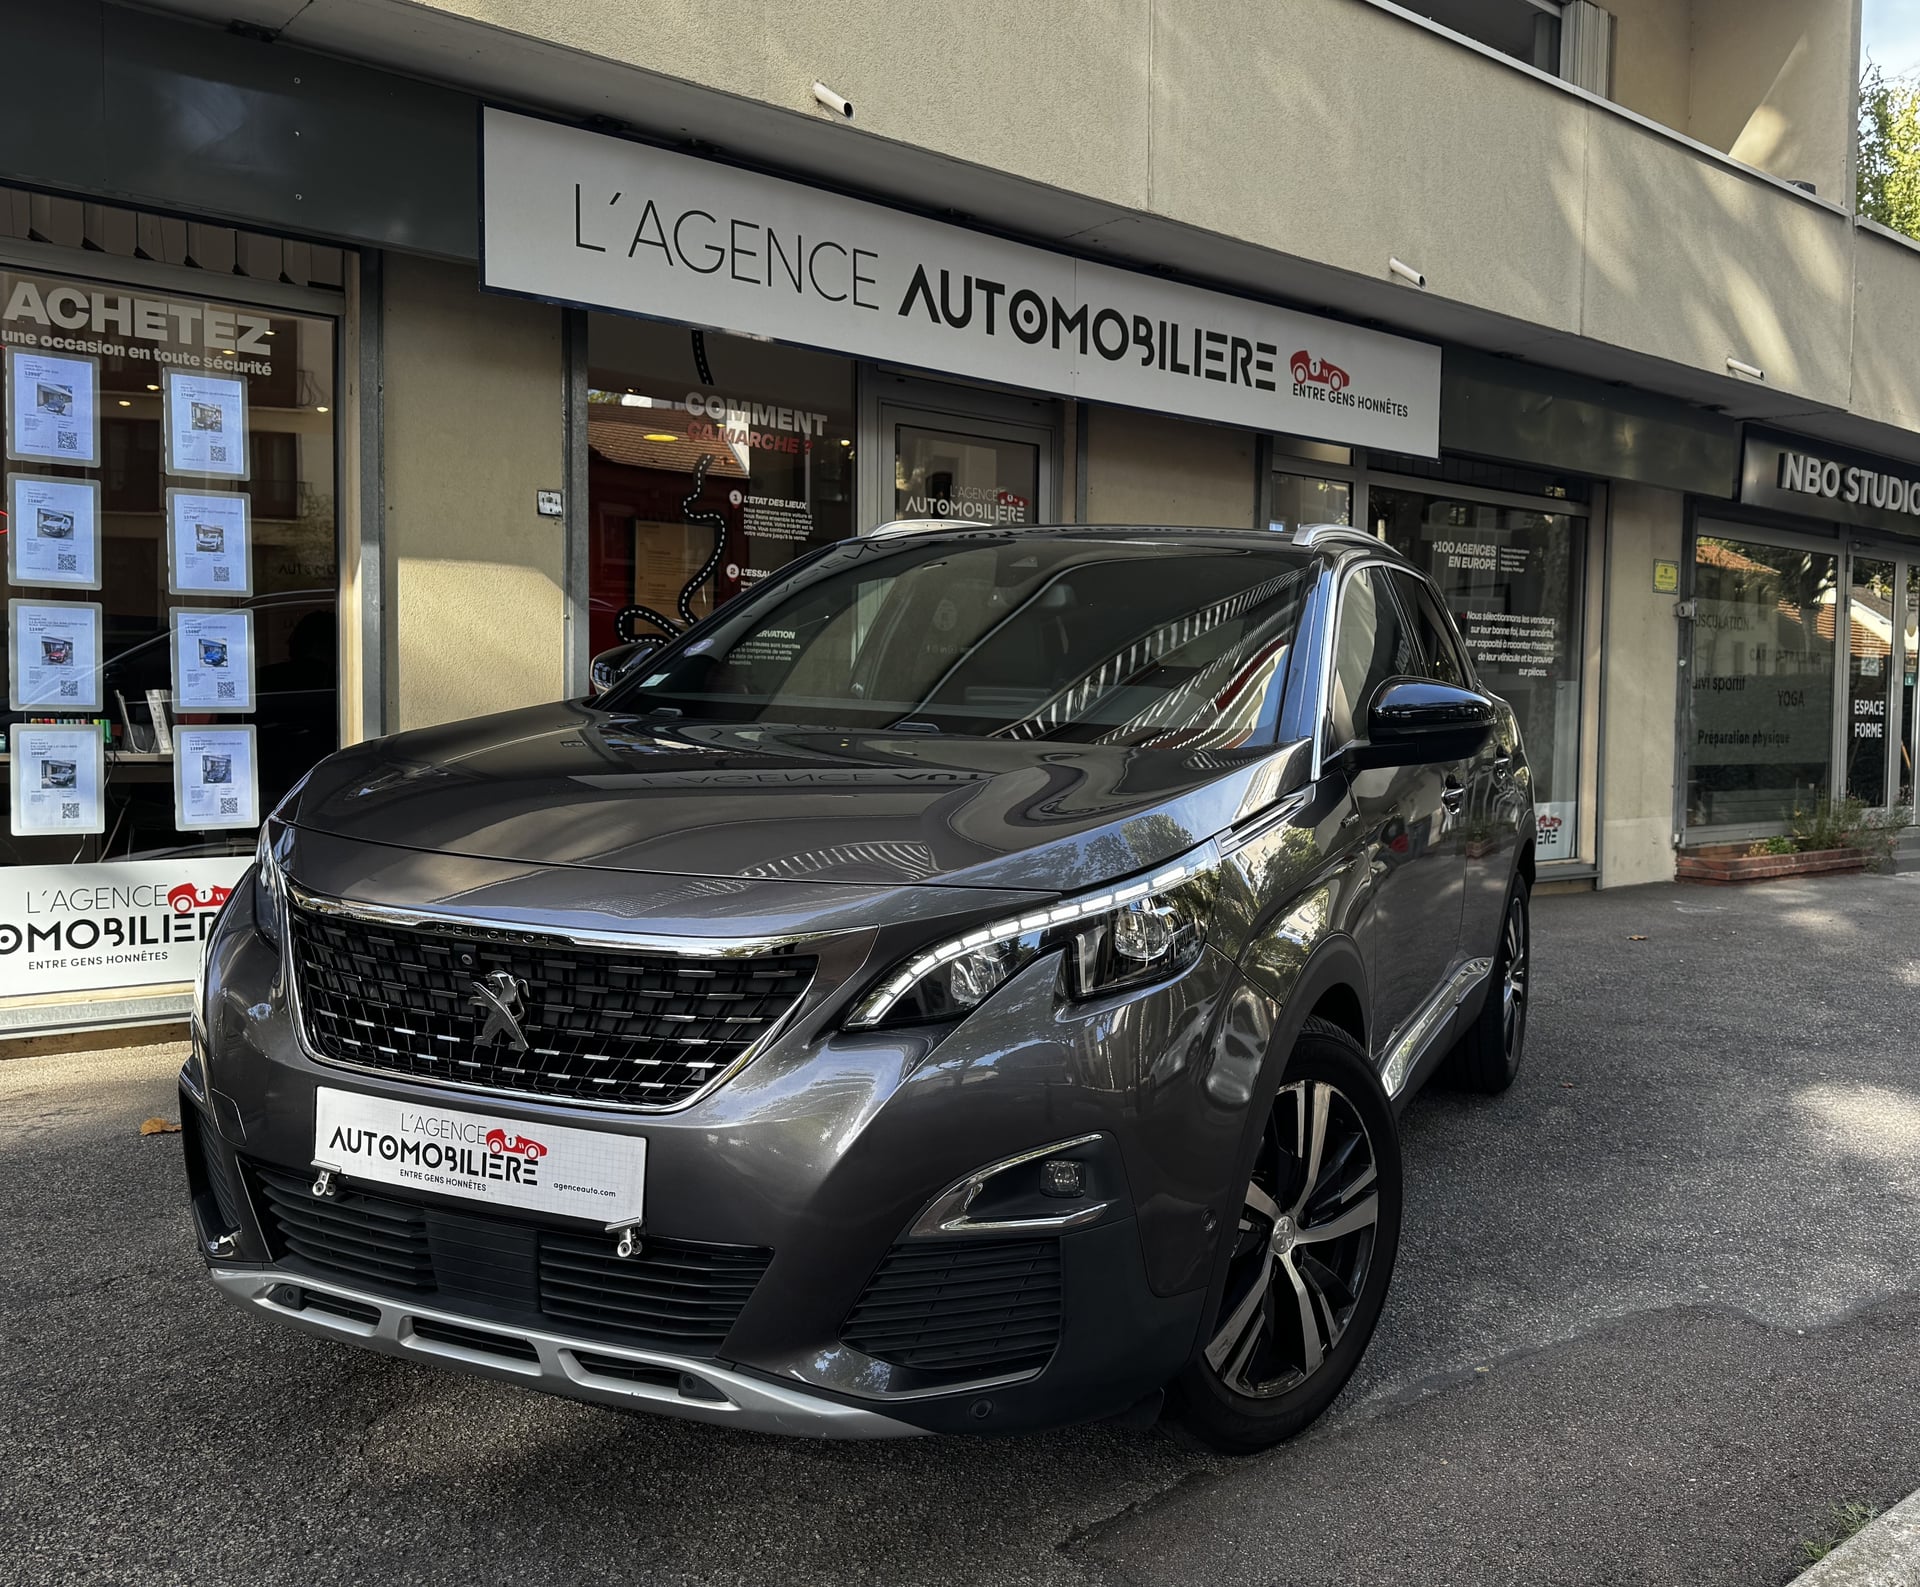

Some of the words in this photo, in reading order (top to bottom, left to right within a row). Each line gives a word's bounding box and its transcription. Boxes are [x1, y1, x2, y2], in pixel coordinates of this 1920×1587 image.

[575, 183, 879, 310] L'AGENCE
[898, 264, 1277, 392] AUTOMOBILIERE
[3, 281, 271, 356] ACHETEZ
[1, 329, 36, 346] une
[40, 334, 125, 358] occasion
[128, 347, 151, 361] en
[154, 350, 200, 368] toute
[203, 355, 272, 377] sécurité
[1292, 382, 1326, 401] ENTRE
[1328, 390, 1355, 407] GENS
[1357, 396, 1409, 418] HONNÊTES
[685, 391, 828, 437] COMMENT
[717, 426, 799, 454] MARCHE
[1781, 452, 1840, 498] NBO
[743, 495, 768, 506] L'ETAT
[768, 498, 784, 508] DES
[785, 500, 807, 510] LIEUX
[1432, 540, 1455, 554] +100
[1455, 542, 1497, 557] AGENCES
[1448, 555, 1461, 568] EN
[1461, 556, 1496, 570] EUROPE
[1466, 611, 1482, 620] Nous
[1530, 616, 1555, 625] vendeurs
[1471, 626, 1480, 634] sur
[1492, 625, 1509, 635] bonne
[1478, 652, 1485, 661] de
[1520, 654, 1527, 662] et
[1518, 668, 1528, 676] sur
[1712, 674, 1746, 694] sportif
[1778, 690, 1805, 707] YOGA
[1854, 700, 1885, 715] ESPACE
[1697, 729, 1750, 748] Préparation
[1752, 730, 1791, 748] physique
[1854, 722, 1883, 738] FORME
[27, 884, 168, 914] L'AGENCE
[28, 959, 67, 970] ENTRE
[70, 956, 103, 967] GENS
[106, 950, 168, 965] HONNÊTES
[400, 1112, 488, 1145] L'AGENCE
[329, 1126, 539, 1186] AUTOMOBILIERE
[400, 1168, 423, 1180] ENTRE
[424, 1173, 445, 1185] GENS
[446, 1177, 487, 1192] HONNÊTES
[553, 1181, 616, 1198] agenceauto.com
